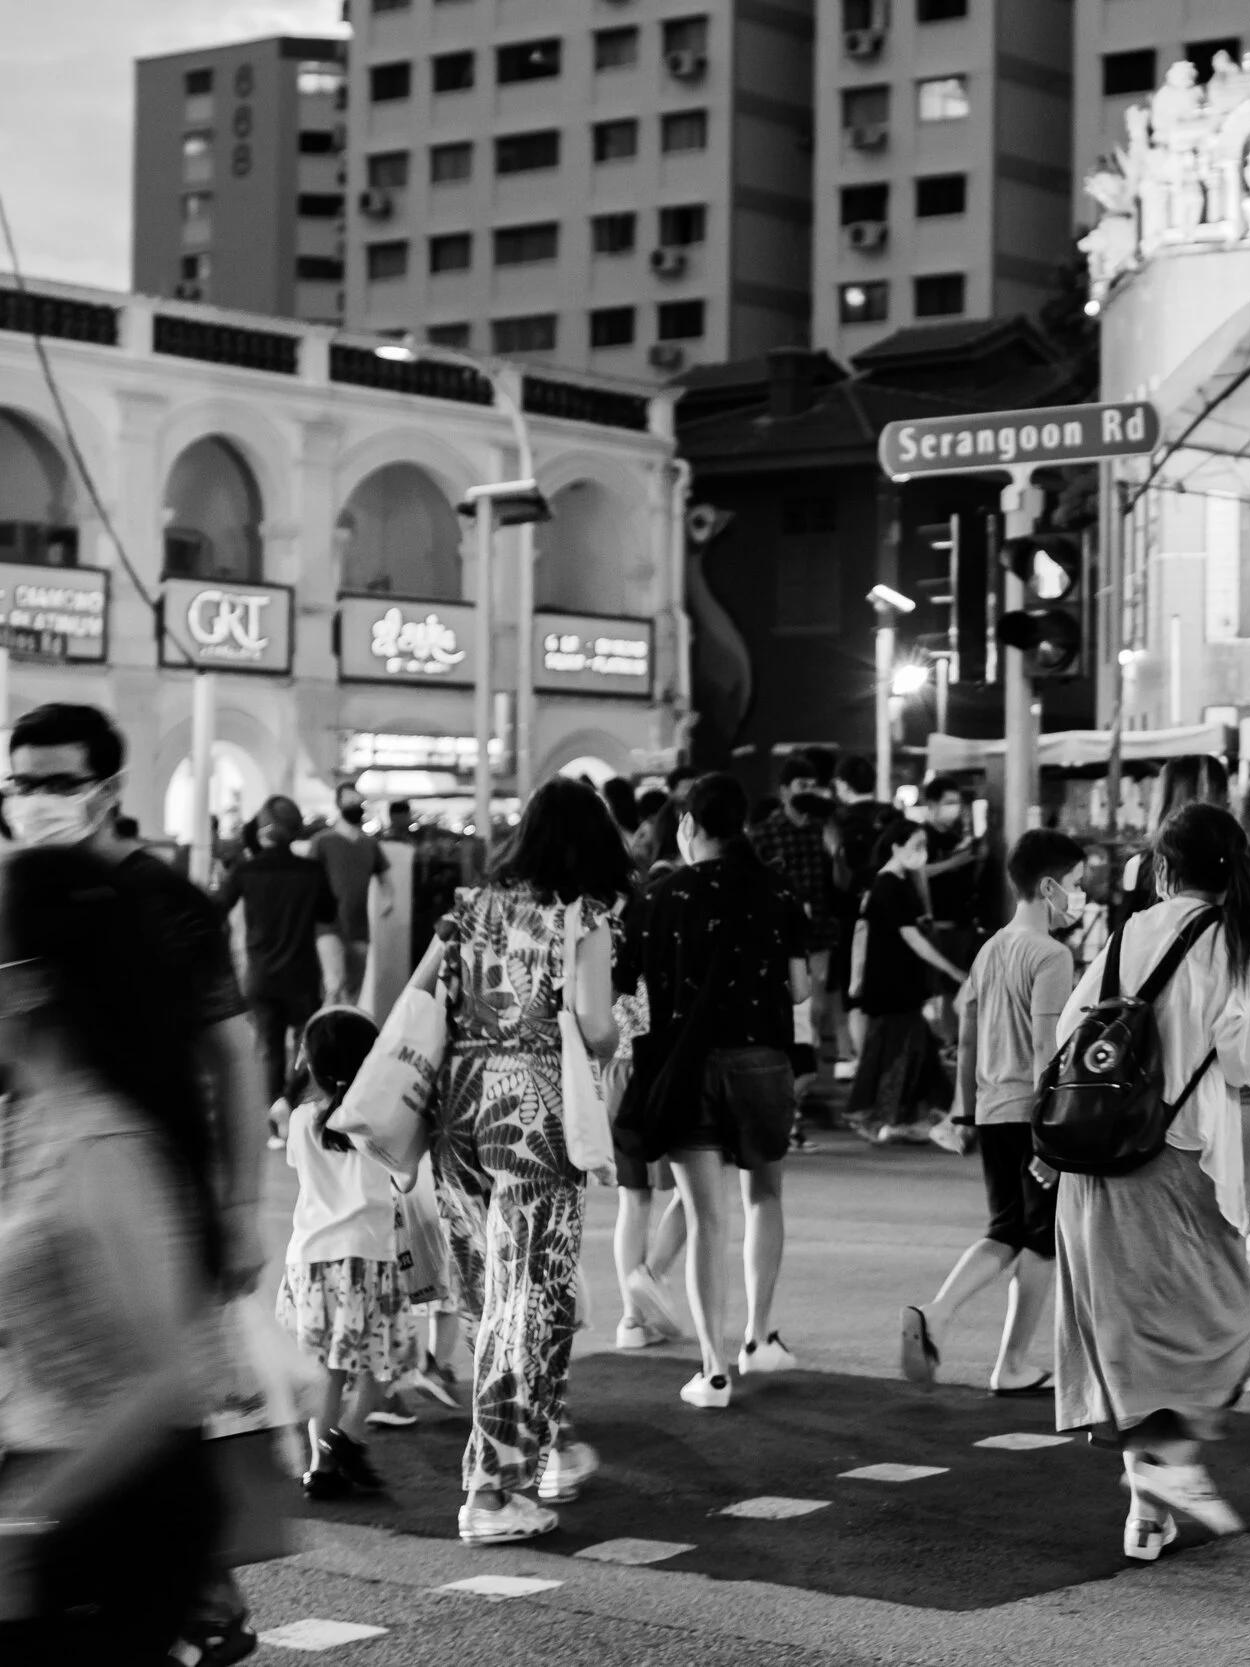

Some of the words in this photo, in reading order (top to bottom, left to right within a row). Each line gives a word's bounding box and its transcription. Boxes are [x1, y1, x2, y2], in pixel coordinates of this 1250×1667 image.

[898, 420, 1083, 461] Serangoon
[1101, 406, 1146, 443] Rd
[187, 589, 271, 650] GRT
